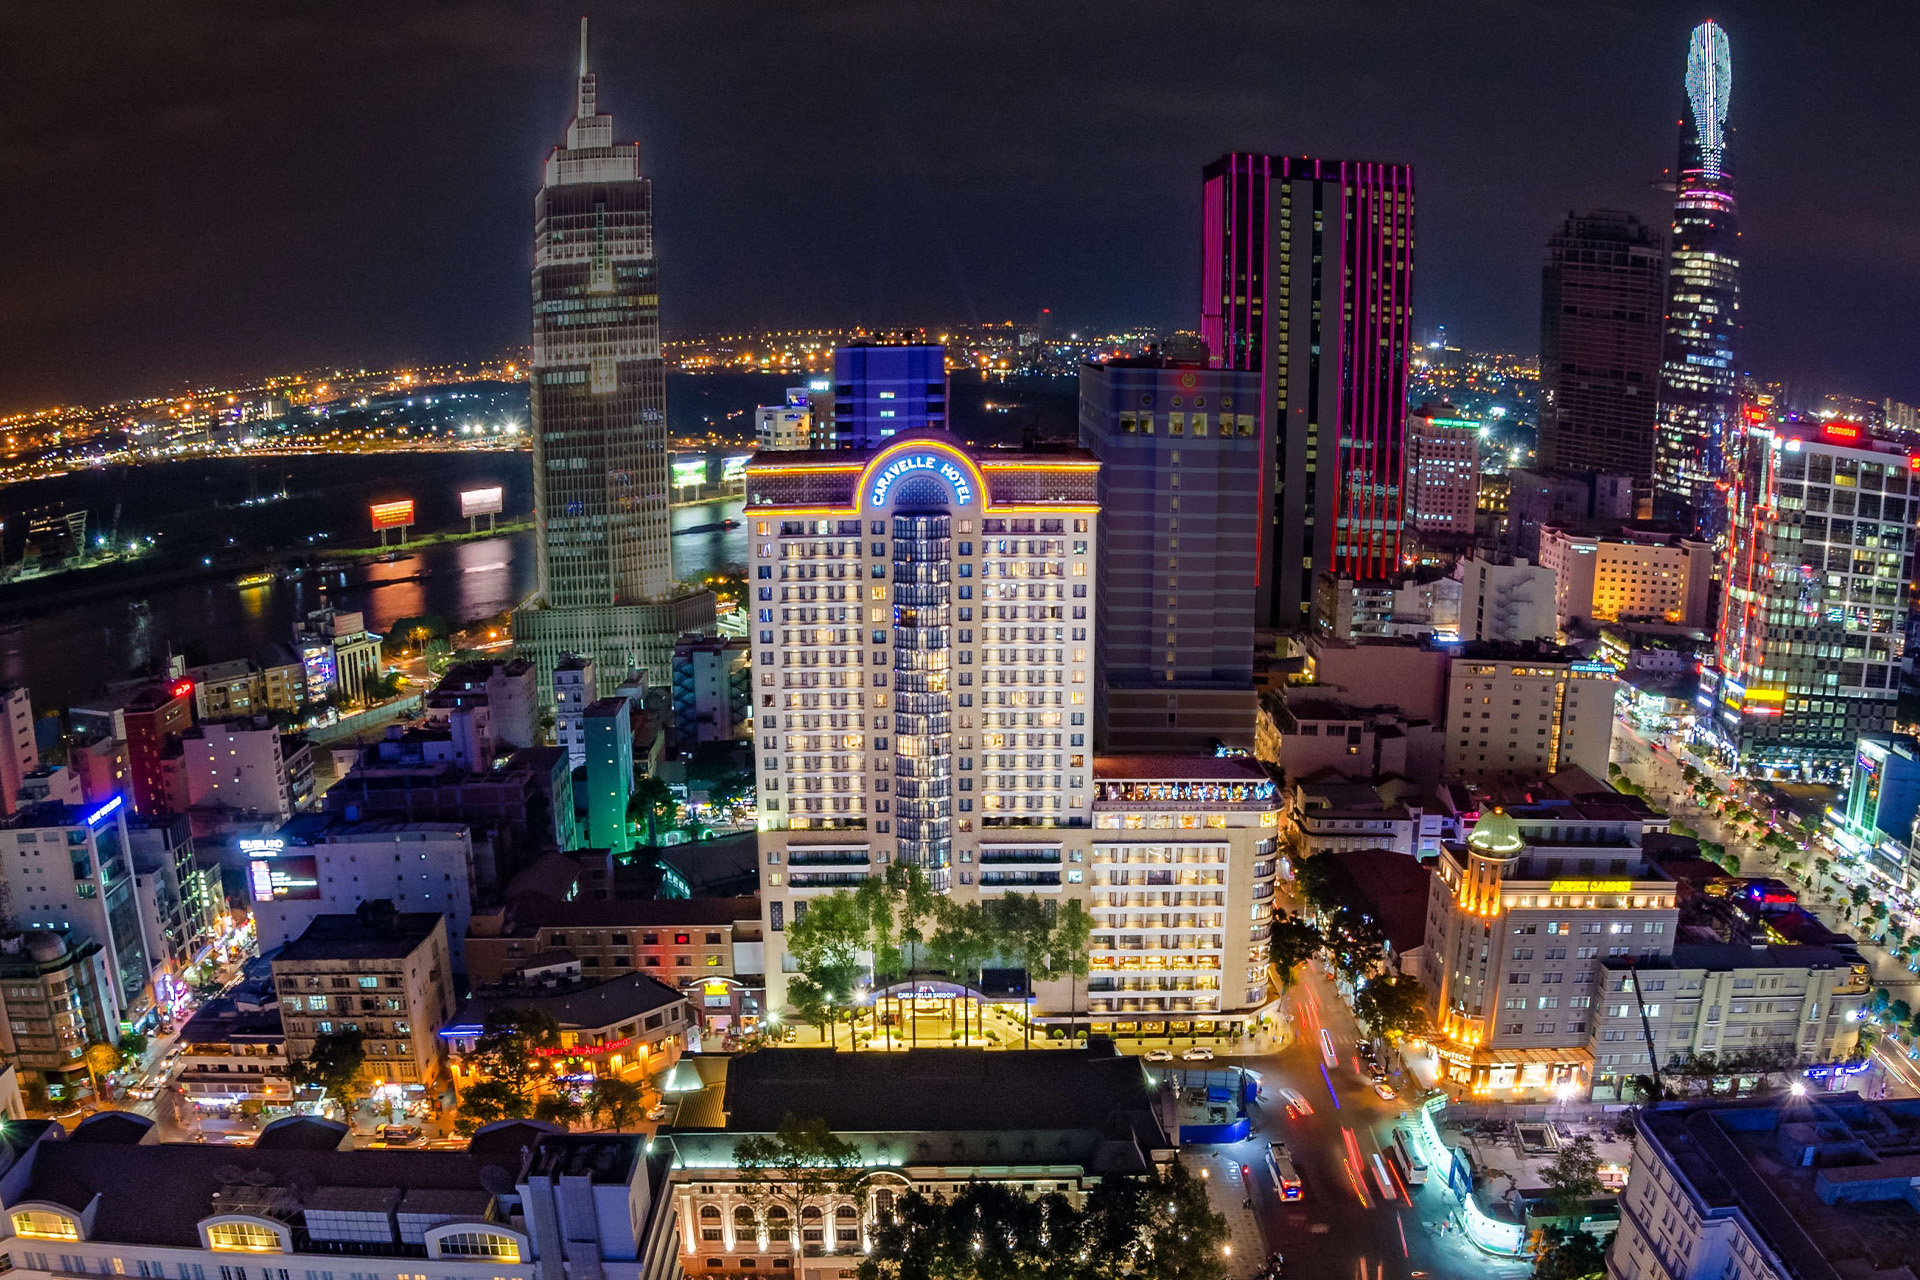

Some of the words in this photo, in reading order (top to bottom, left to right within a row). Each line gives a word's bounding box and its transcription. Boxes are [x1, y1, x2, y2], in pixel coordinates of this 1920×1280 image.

[872, 456, 936, 507] CARAVELLE
[940, 463, 971, 505] HOTEL
[1438, 1048, 1471, 1062] VUITTON
